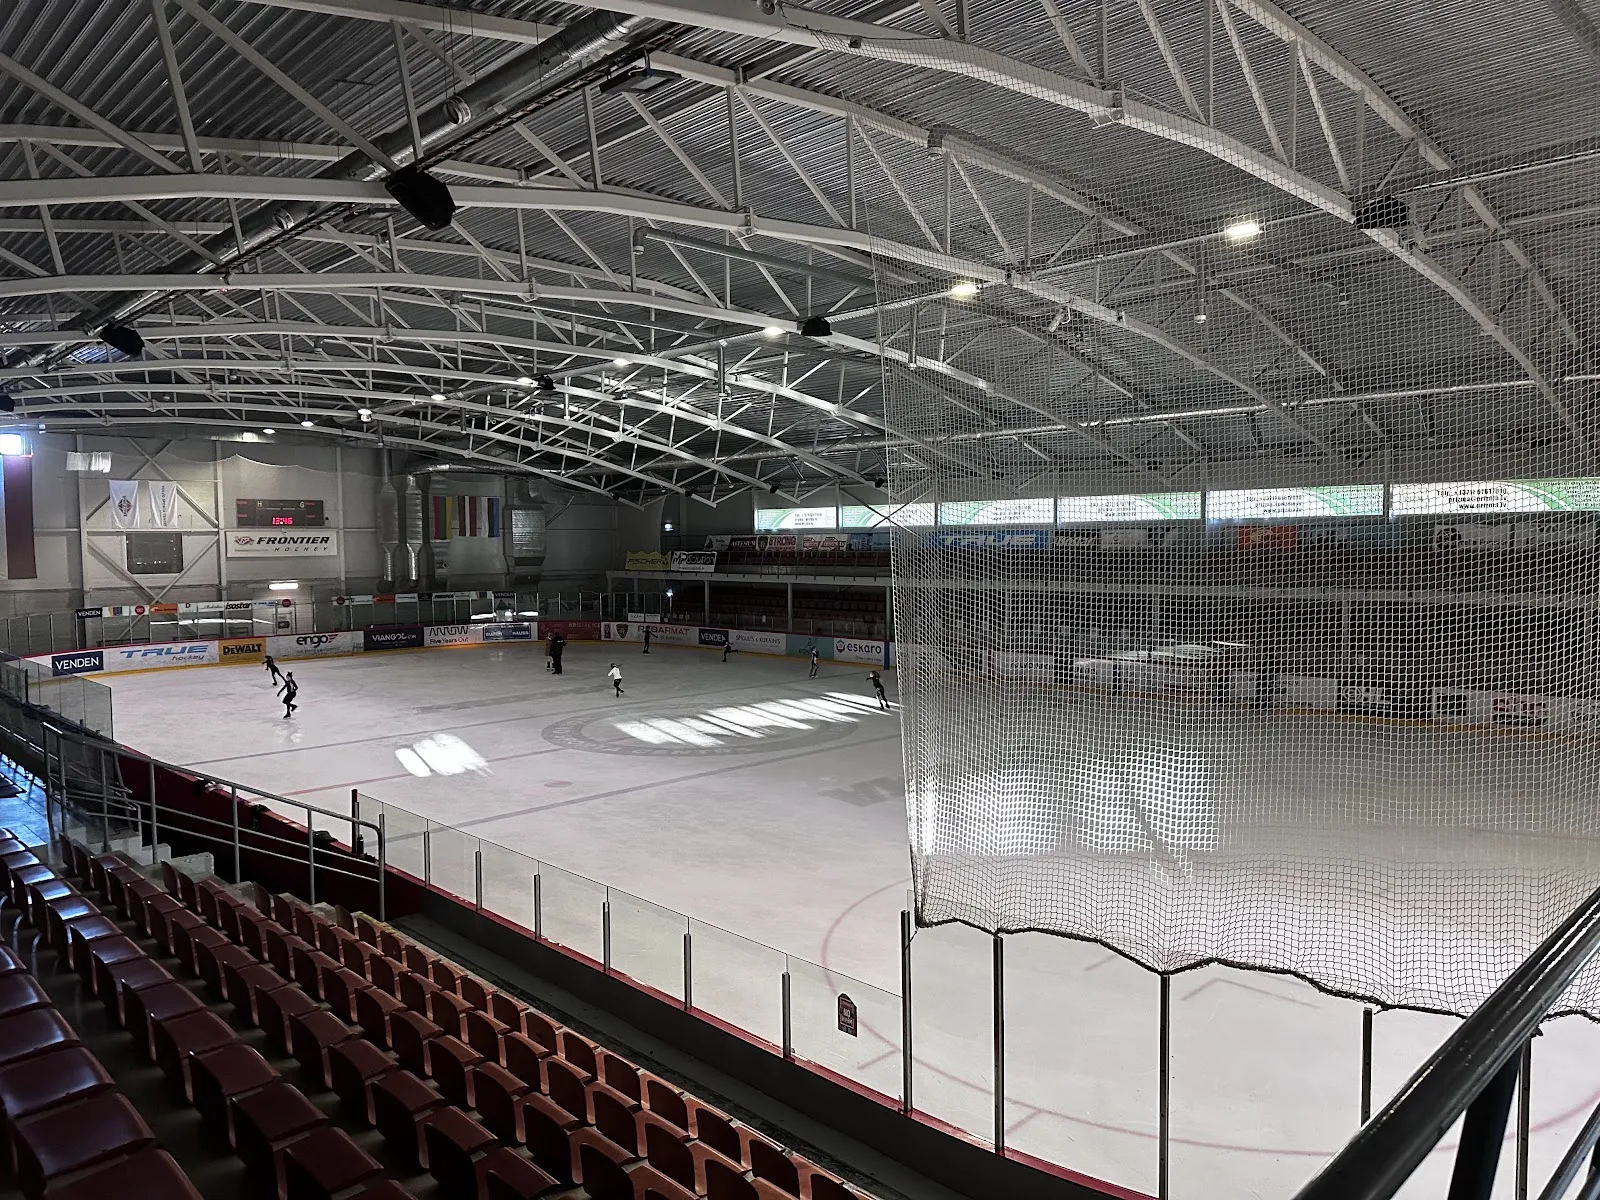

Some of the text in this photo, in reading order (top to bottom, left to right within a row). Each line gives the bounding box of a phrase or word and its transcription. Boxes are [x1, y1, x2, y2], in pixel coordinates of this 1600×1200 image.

[256, 536, 330, 545] FRONTIER
[225, 602, 253, 610] isostar
[77, 609, 101, 617] VENDEN
[428, 625, 469, 637] ARROW
[637, 625, 690, 636] RBARMAT
[296, 634, 329, 648] engo
[846, 640, 882, 654] eskaro
[119, 644, 209, 659] TRUE
[55, 656, 99, 670] VENDEN
